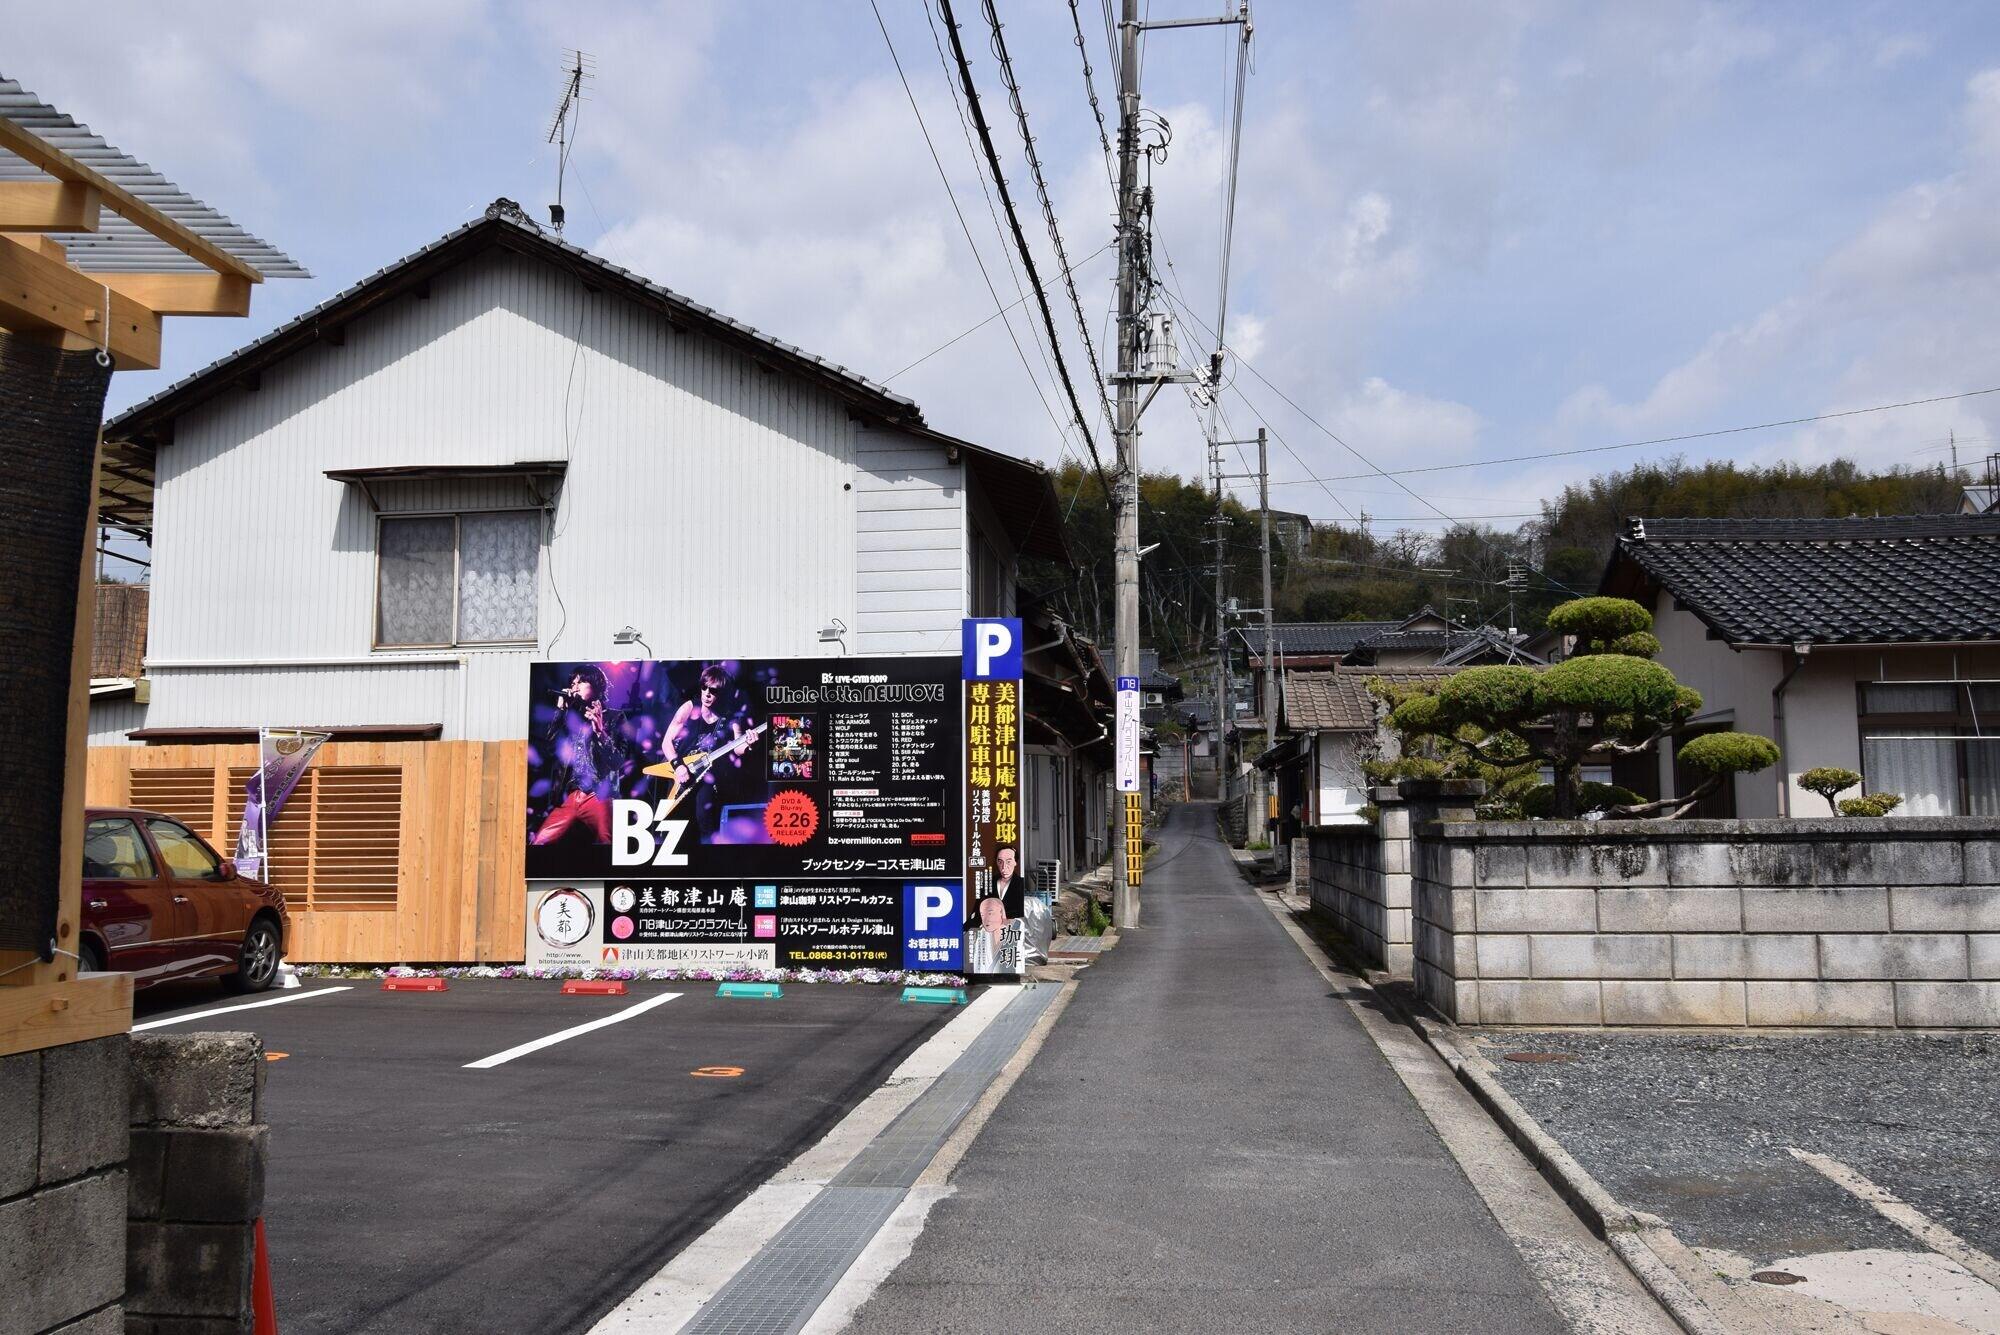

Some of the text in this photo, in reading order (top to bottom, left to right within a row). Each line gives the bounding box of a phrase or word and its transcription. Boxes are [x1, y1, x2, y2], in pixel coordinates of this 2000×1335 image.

[976, 623, 1012, 676] P
[835, 675, 869, 684] LIVE-GYM
[870, 675, 888, 684] 2019
[766, 686, 820, 704] Whole
[864, 684, 904, 702] NEW
[904, 684, 944, 702] LOVE
[970, 682, 992, 788] 専用駐車場
[982, 790, 990, 824] 美都地区
[772, 812, 810, 828] 2.26
[612, 799, 690, 866] B'z
[828, 836, 902, 844] bz-vermillion.com
[802, 858, 946, 870] ブックセンターコスモ津山店
[640, 886, 748, 907] 美都津山庵
[819, 896, 894, 905] リストワールカフェ
[914, 886, 954, 930] P
[780, 924, 894, 936] リストワールホテル津山
[908, 938, 959, 949] お客様専用
[1000, 924, 1021, 968] 珈琲
[622, 948, 769, 960] 津山美都地区リストワール小路
[918, 950, 950, 962] 駐車場
